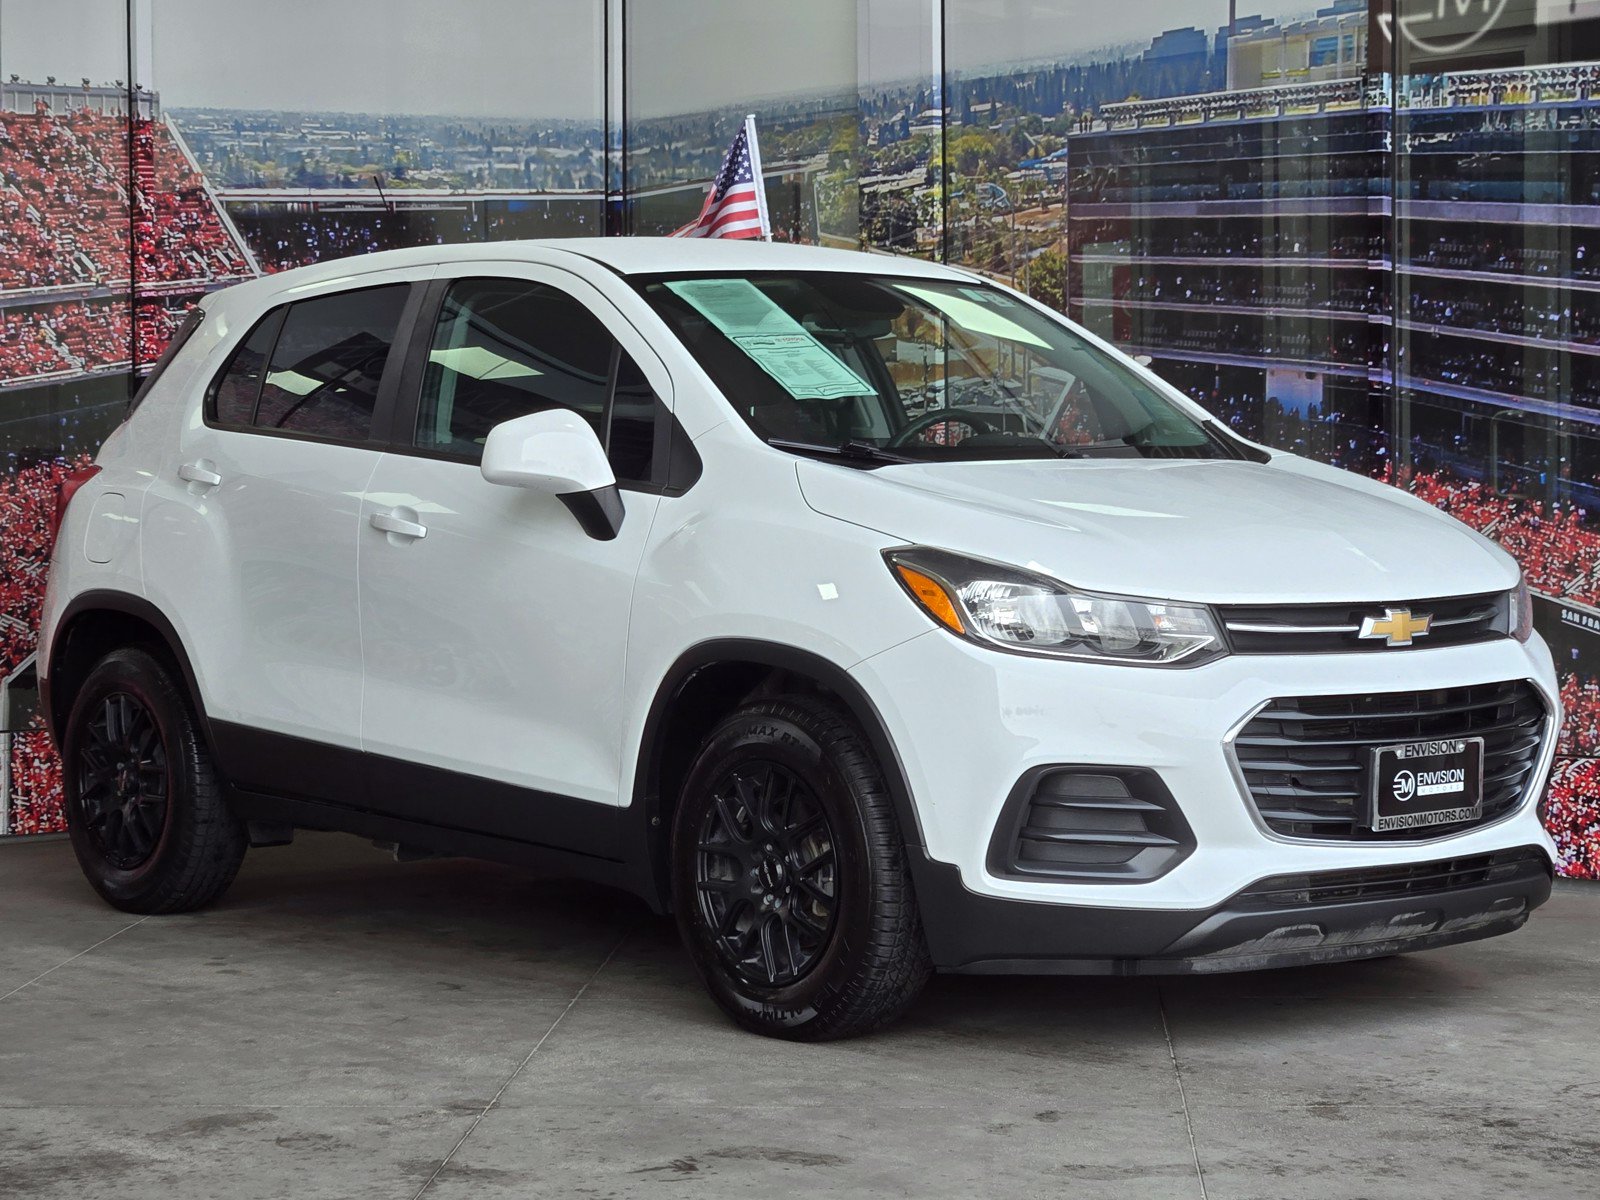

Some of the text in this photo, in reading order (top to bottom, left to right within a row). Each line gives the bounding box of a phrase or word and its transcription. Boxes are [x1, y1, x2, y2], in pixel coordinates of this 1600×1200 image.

[1561, 609, 1580, 623] SAN
[1404, 740, 1457, 758] ENVISION
[1417, 768, 1465, 786] ENVISION
[1378, 807, 1478, 830] ENVISIONMOTORS.COM
